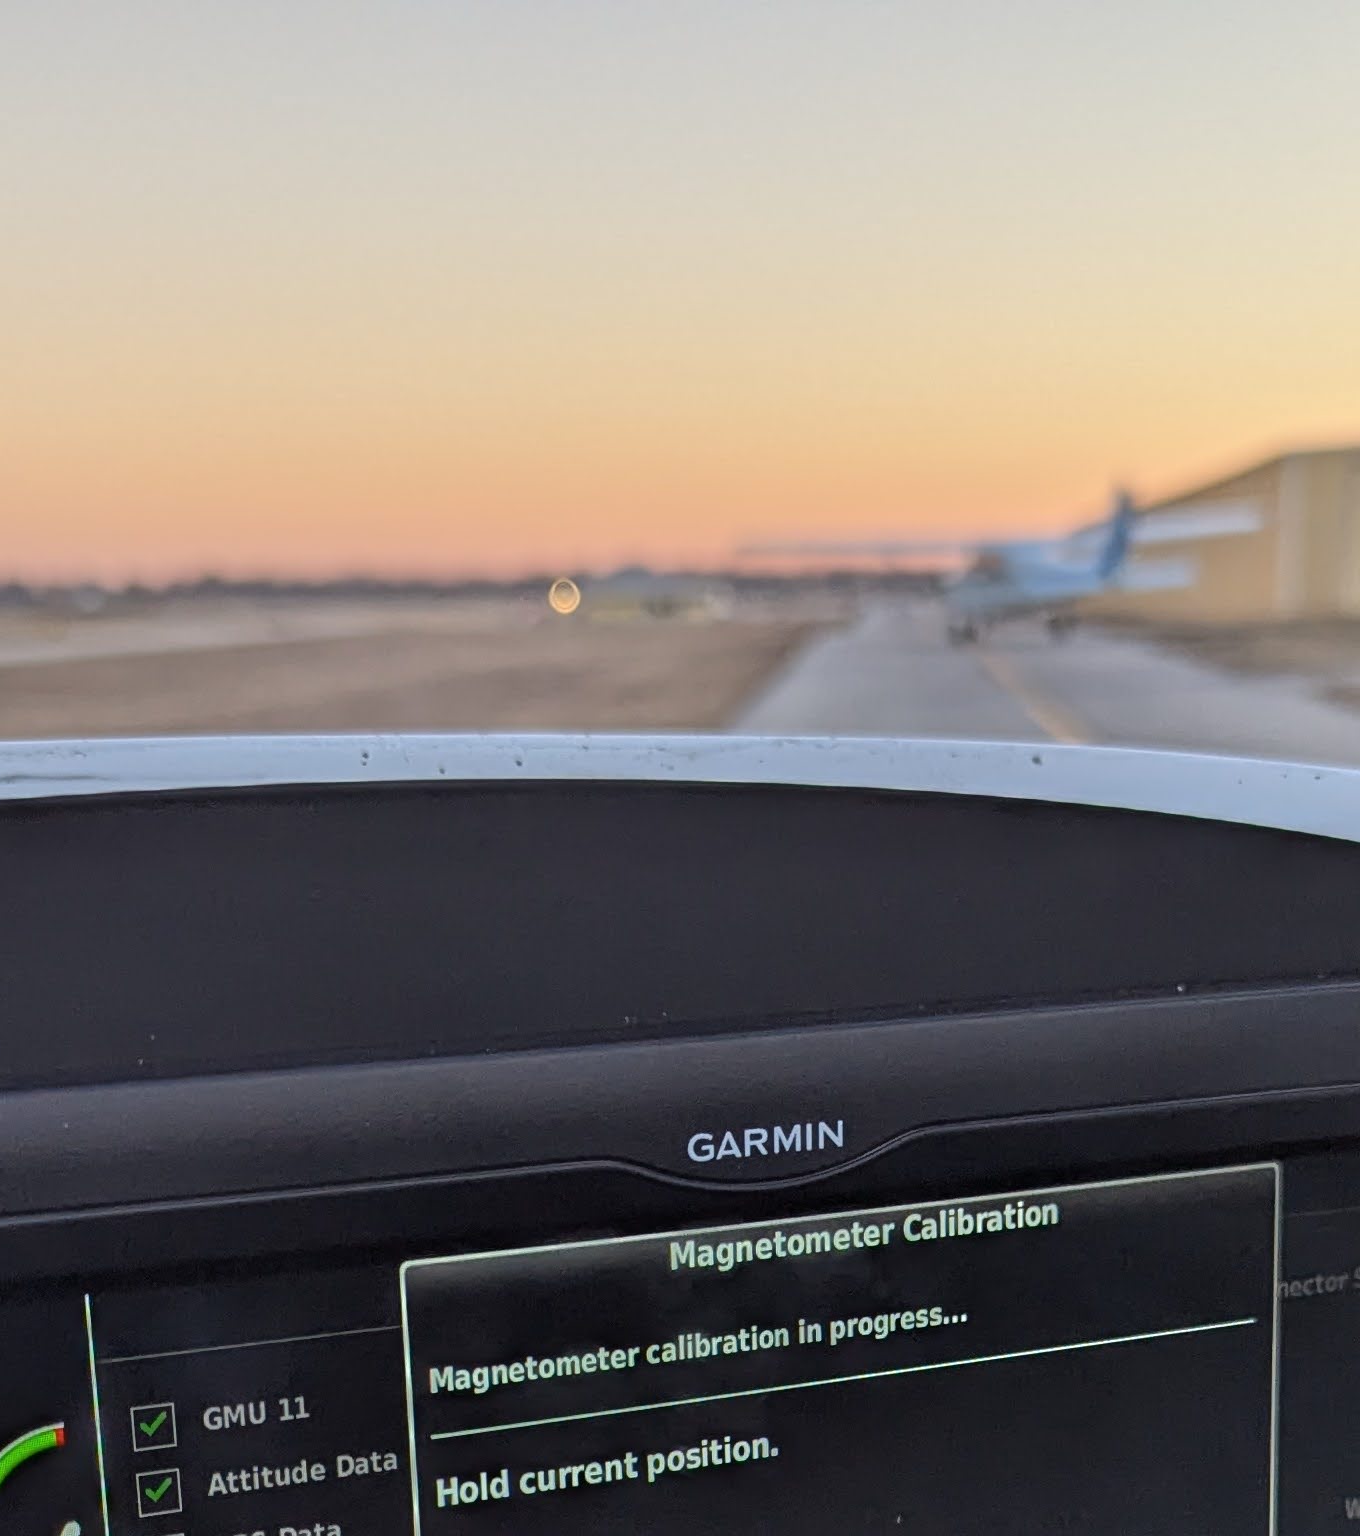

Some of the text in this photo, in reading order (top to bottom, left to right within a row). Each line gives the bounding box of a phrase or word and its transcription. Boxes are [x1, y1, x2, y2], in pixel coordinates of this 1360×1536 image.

[687, 1121, 844, 1162] GARMIN
[670, 1199, 1059, 1271] Magnetometer Calibration
[429, 1305, 968, 1395] Magnetometer calibration in progress...
[202, 1395, 311, 1431] GMU 11
[207, 1451, 399, 1497] Attitude Data
[436, 1433, 780, 1508] Hold current position.
